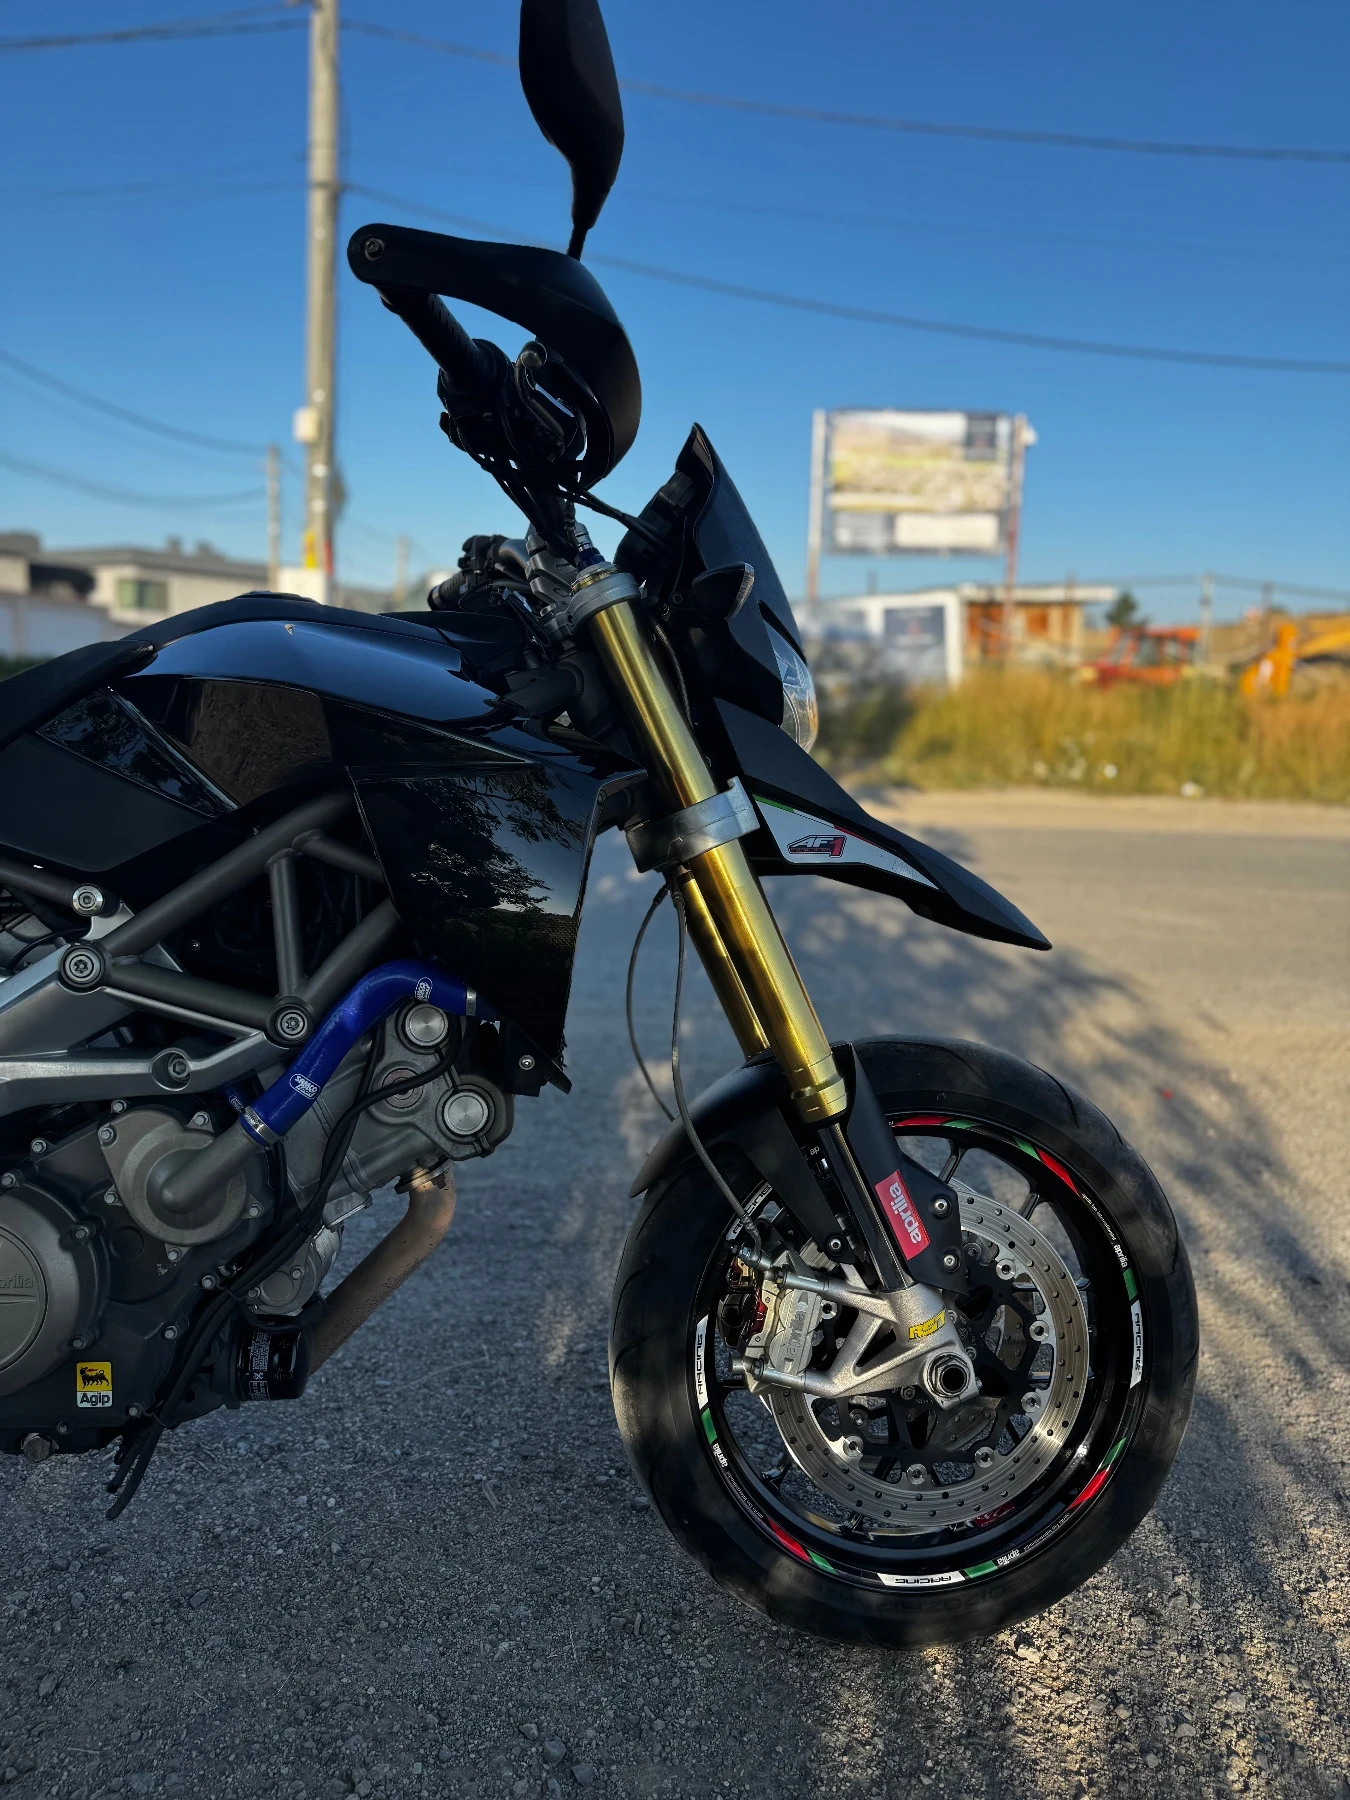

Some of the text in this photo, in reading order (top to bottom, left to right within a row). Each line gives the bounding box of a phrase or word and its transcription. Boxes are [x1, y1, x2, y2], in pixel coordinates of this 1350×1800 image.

[889, 1181, 922, 1244] aprilia
[1113, 1243, 1129, 1268] aprilia
[1134, 1312, 1142, 1371] RACING
[696, 1333, 704, 1395] RACING
[80, 1392, 111, 1406] Agip
[712, 1442, 728, 1468] aprilia
[997, 1549, 1019, 1565] aprilia
[895, 1575, 952, 1585] RACING
